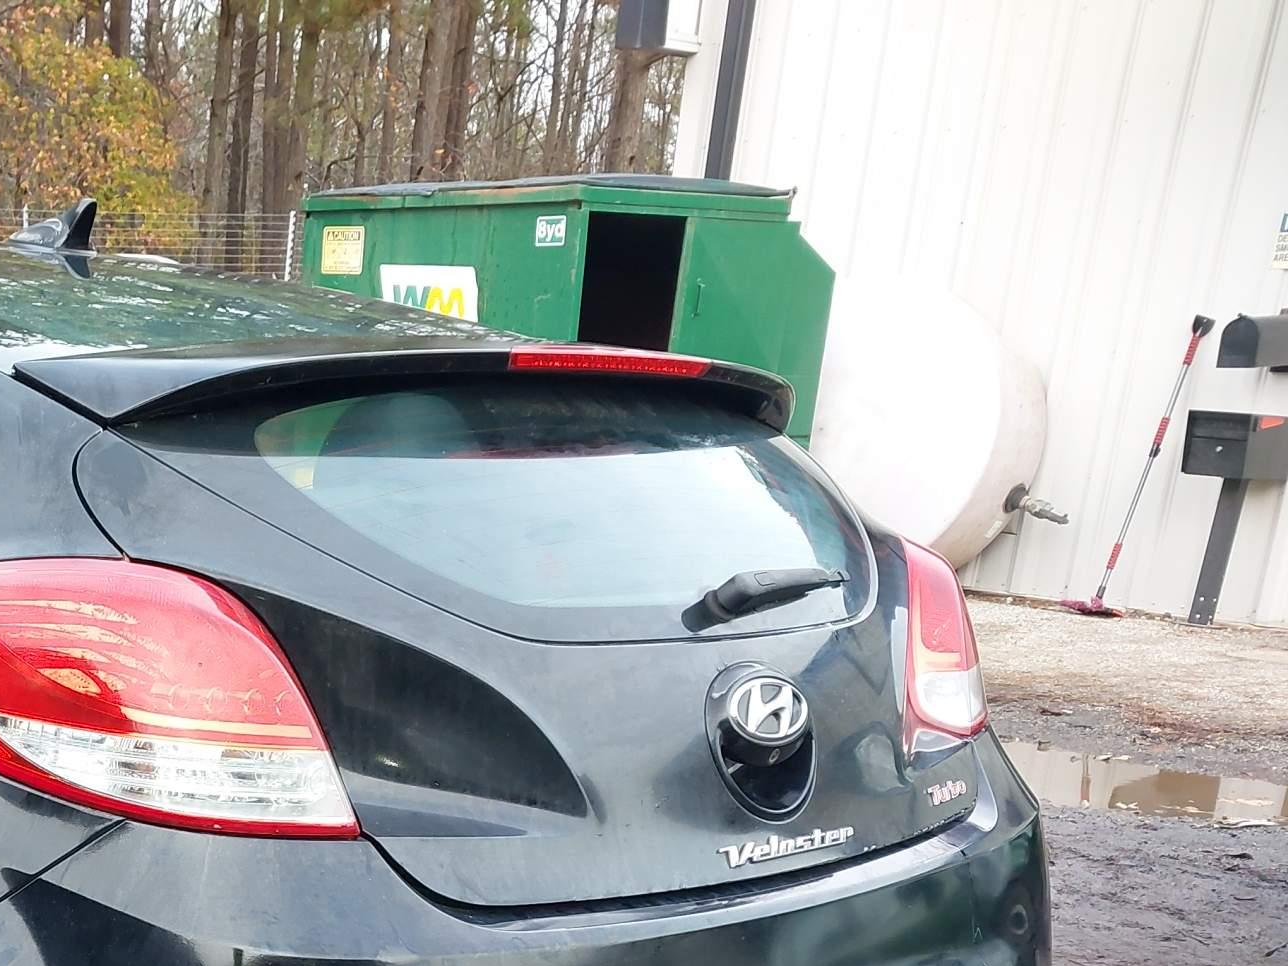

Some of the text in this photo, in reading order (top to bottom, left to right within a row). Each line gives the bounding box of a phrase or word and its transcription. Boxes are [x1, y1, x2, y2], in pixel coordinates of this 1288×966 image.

[333, 231, 360, 241] CAUTION
[392, 284, 464, 319] WM
[927, 780, 967, 806] Turbo
[718, 826, 854, 868] Veloster
